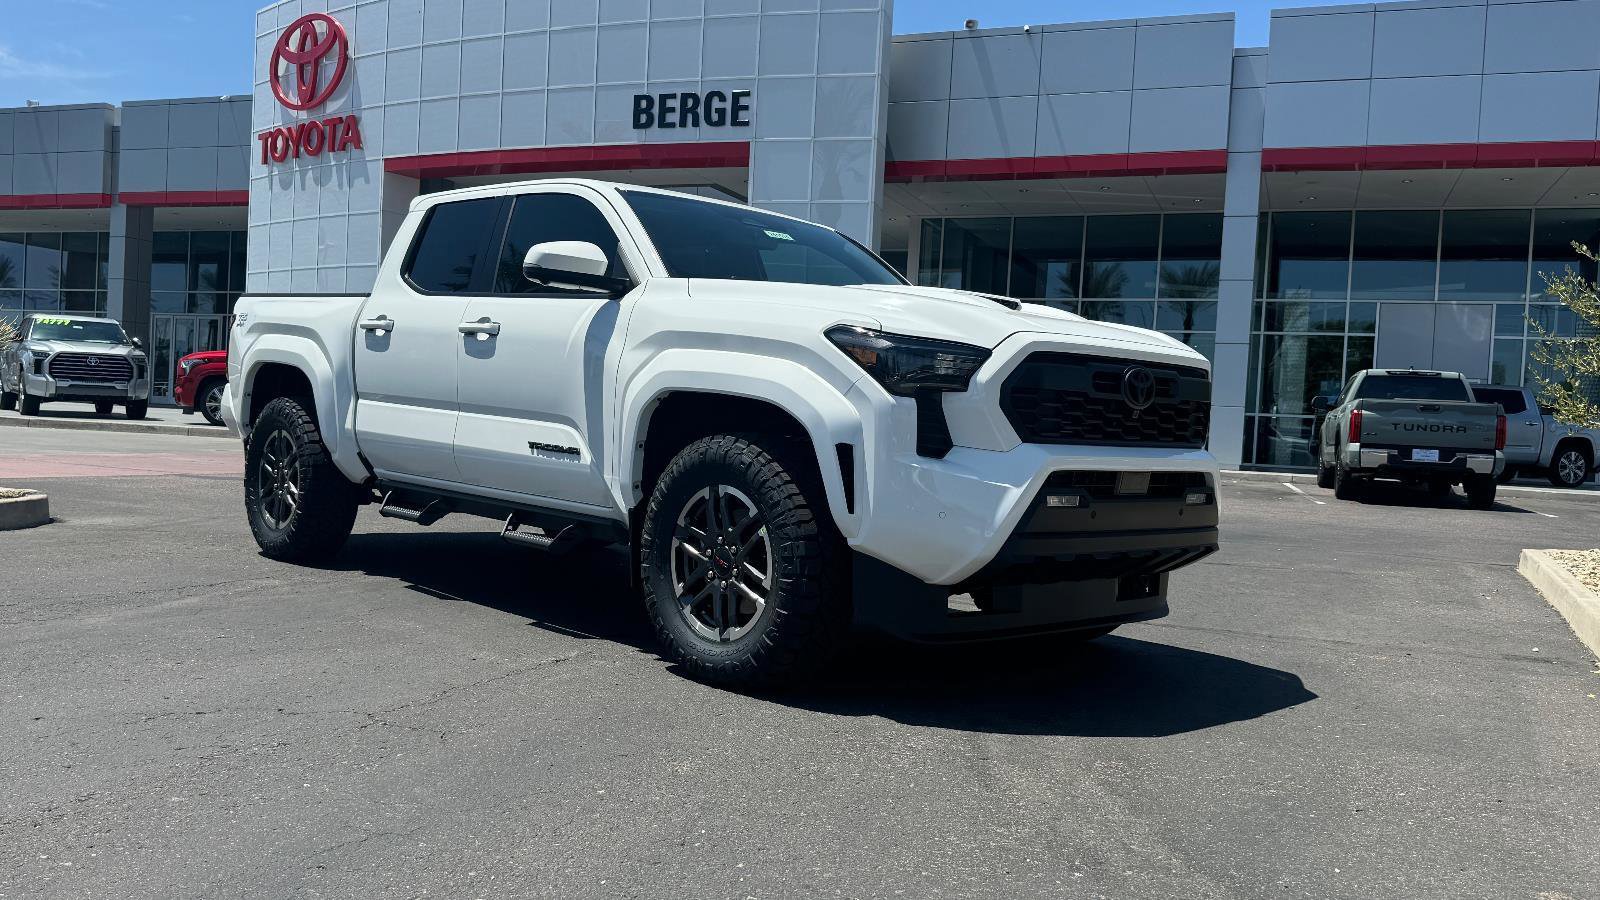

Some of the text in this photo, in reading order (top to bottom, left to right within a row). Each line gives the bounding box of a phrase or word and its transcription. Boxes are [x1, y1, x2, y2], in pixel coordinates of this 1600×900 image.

[633, 90, 751, 129] BERGE
[258, 115, 363, 165] TOYOTA
[1392, 423, 1467, 434] TUNDRA
